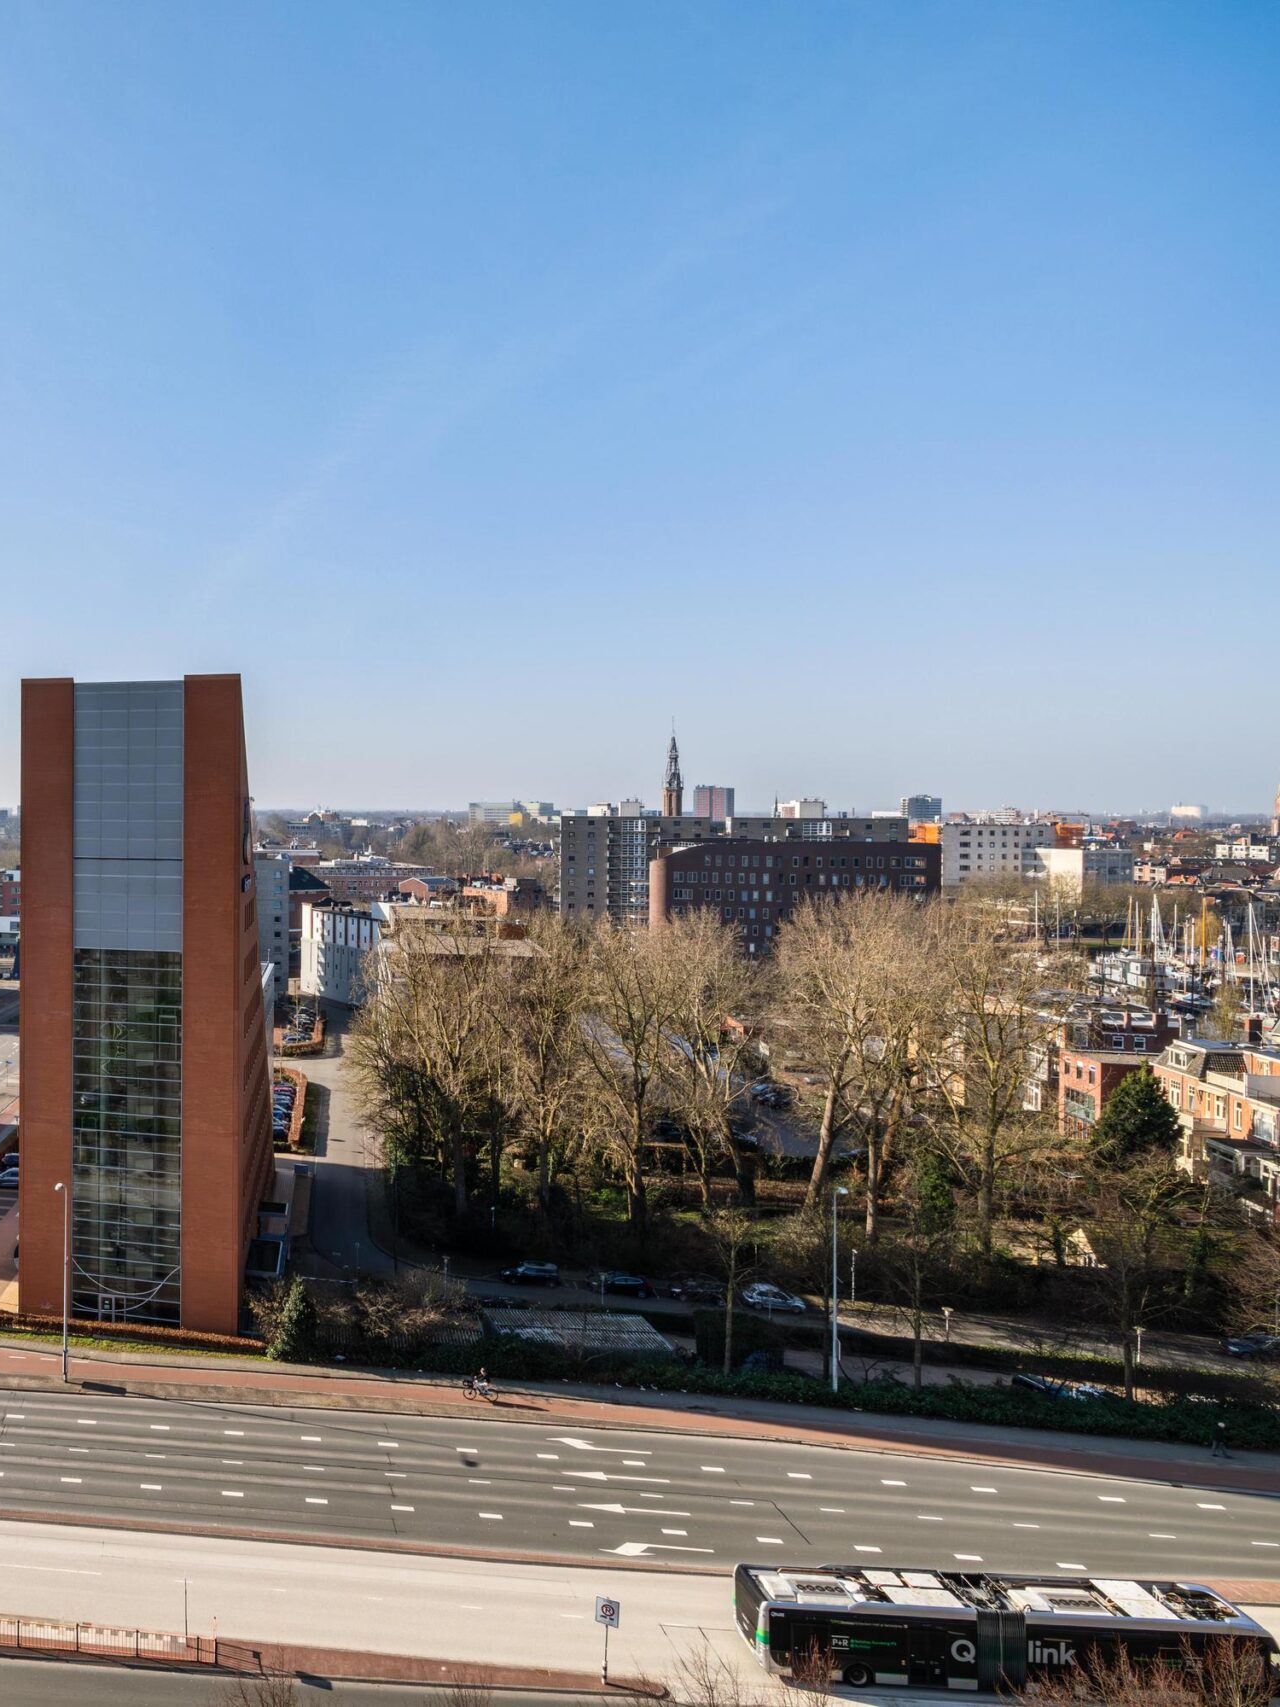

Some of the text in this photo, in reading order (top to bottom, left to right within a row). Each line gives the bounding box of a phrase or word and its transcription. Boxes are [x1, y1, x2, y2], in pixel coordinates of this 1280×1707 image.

[832, 1638, 849, 1647] P+R
[950, 1639, 1077, 1665] Q link
